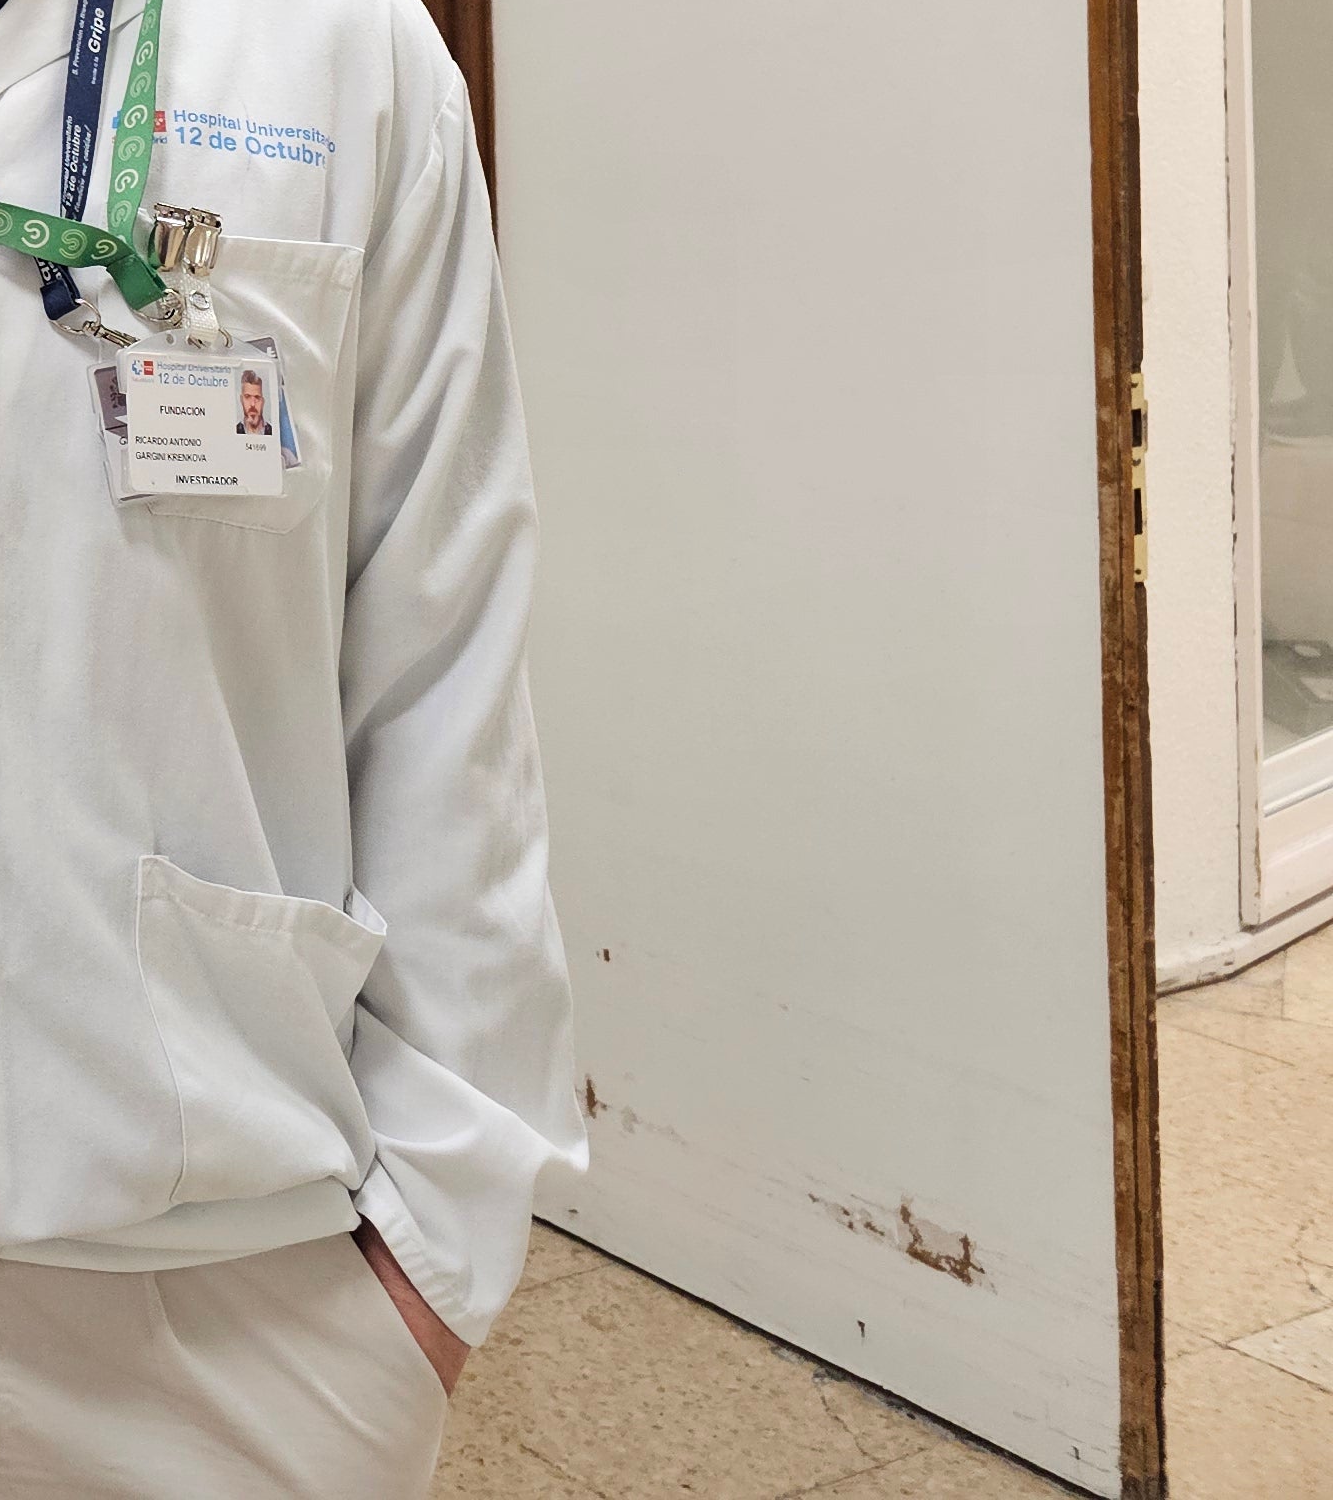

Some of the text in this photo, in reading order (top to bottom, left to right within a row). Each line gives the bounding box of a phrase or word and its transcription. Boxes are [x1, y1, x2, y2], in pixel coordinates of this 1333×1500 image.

[88, 8, 105, 53] Gripe
[173, 110, 241, 131] Hospital
[174, 126, 202, 146] 12
[209, 131, 237, 151] de
[157, 361, 231, 373] Hospital Universitario
[158, 373, 170, 384] 12
[172, 373, 185, 384] de
[188, 374, 229, 387] Octubre
[159, 405, 206, 416] FUNDACION
[135, 436, 167, 445] RICARDO
[169, 438, 202, 447] ANTONIO
[176, 475, 238, 486] INVESTIGADOR
